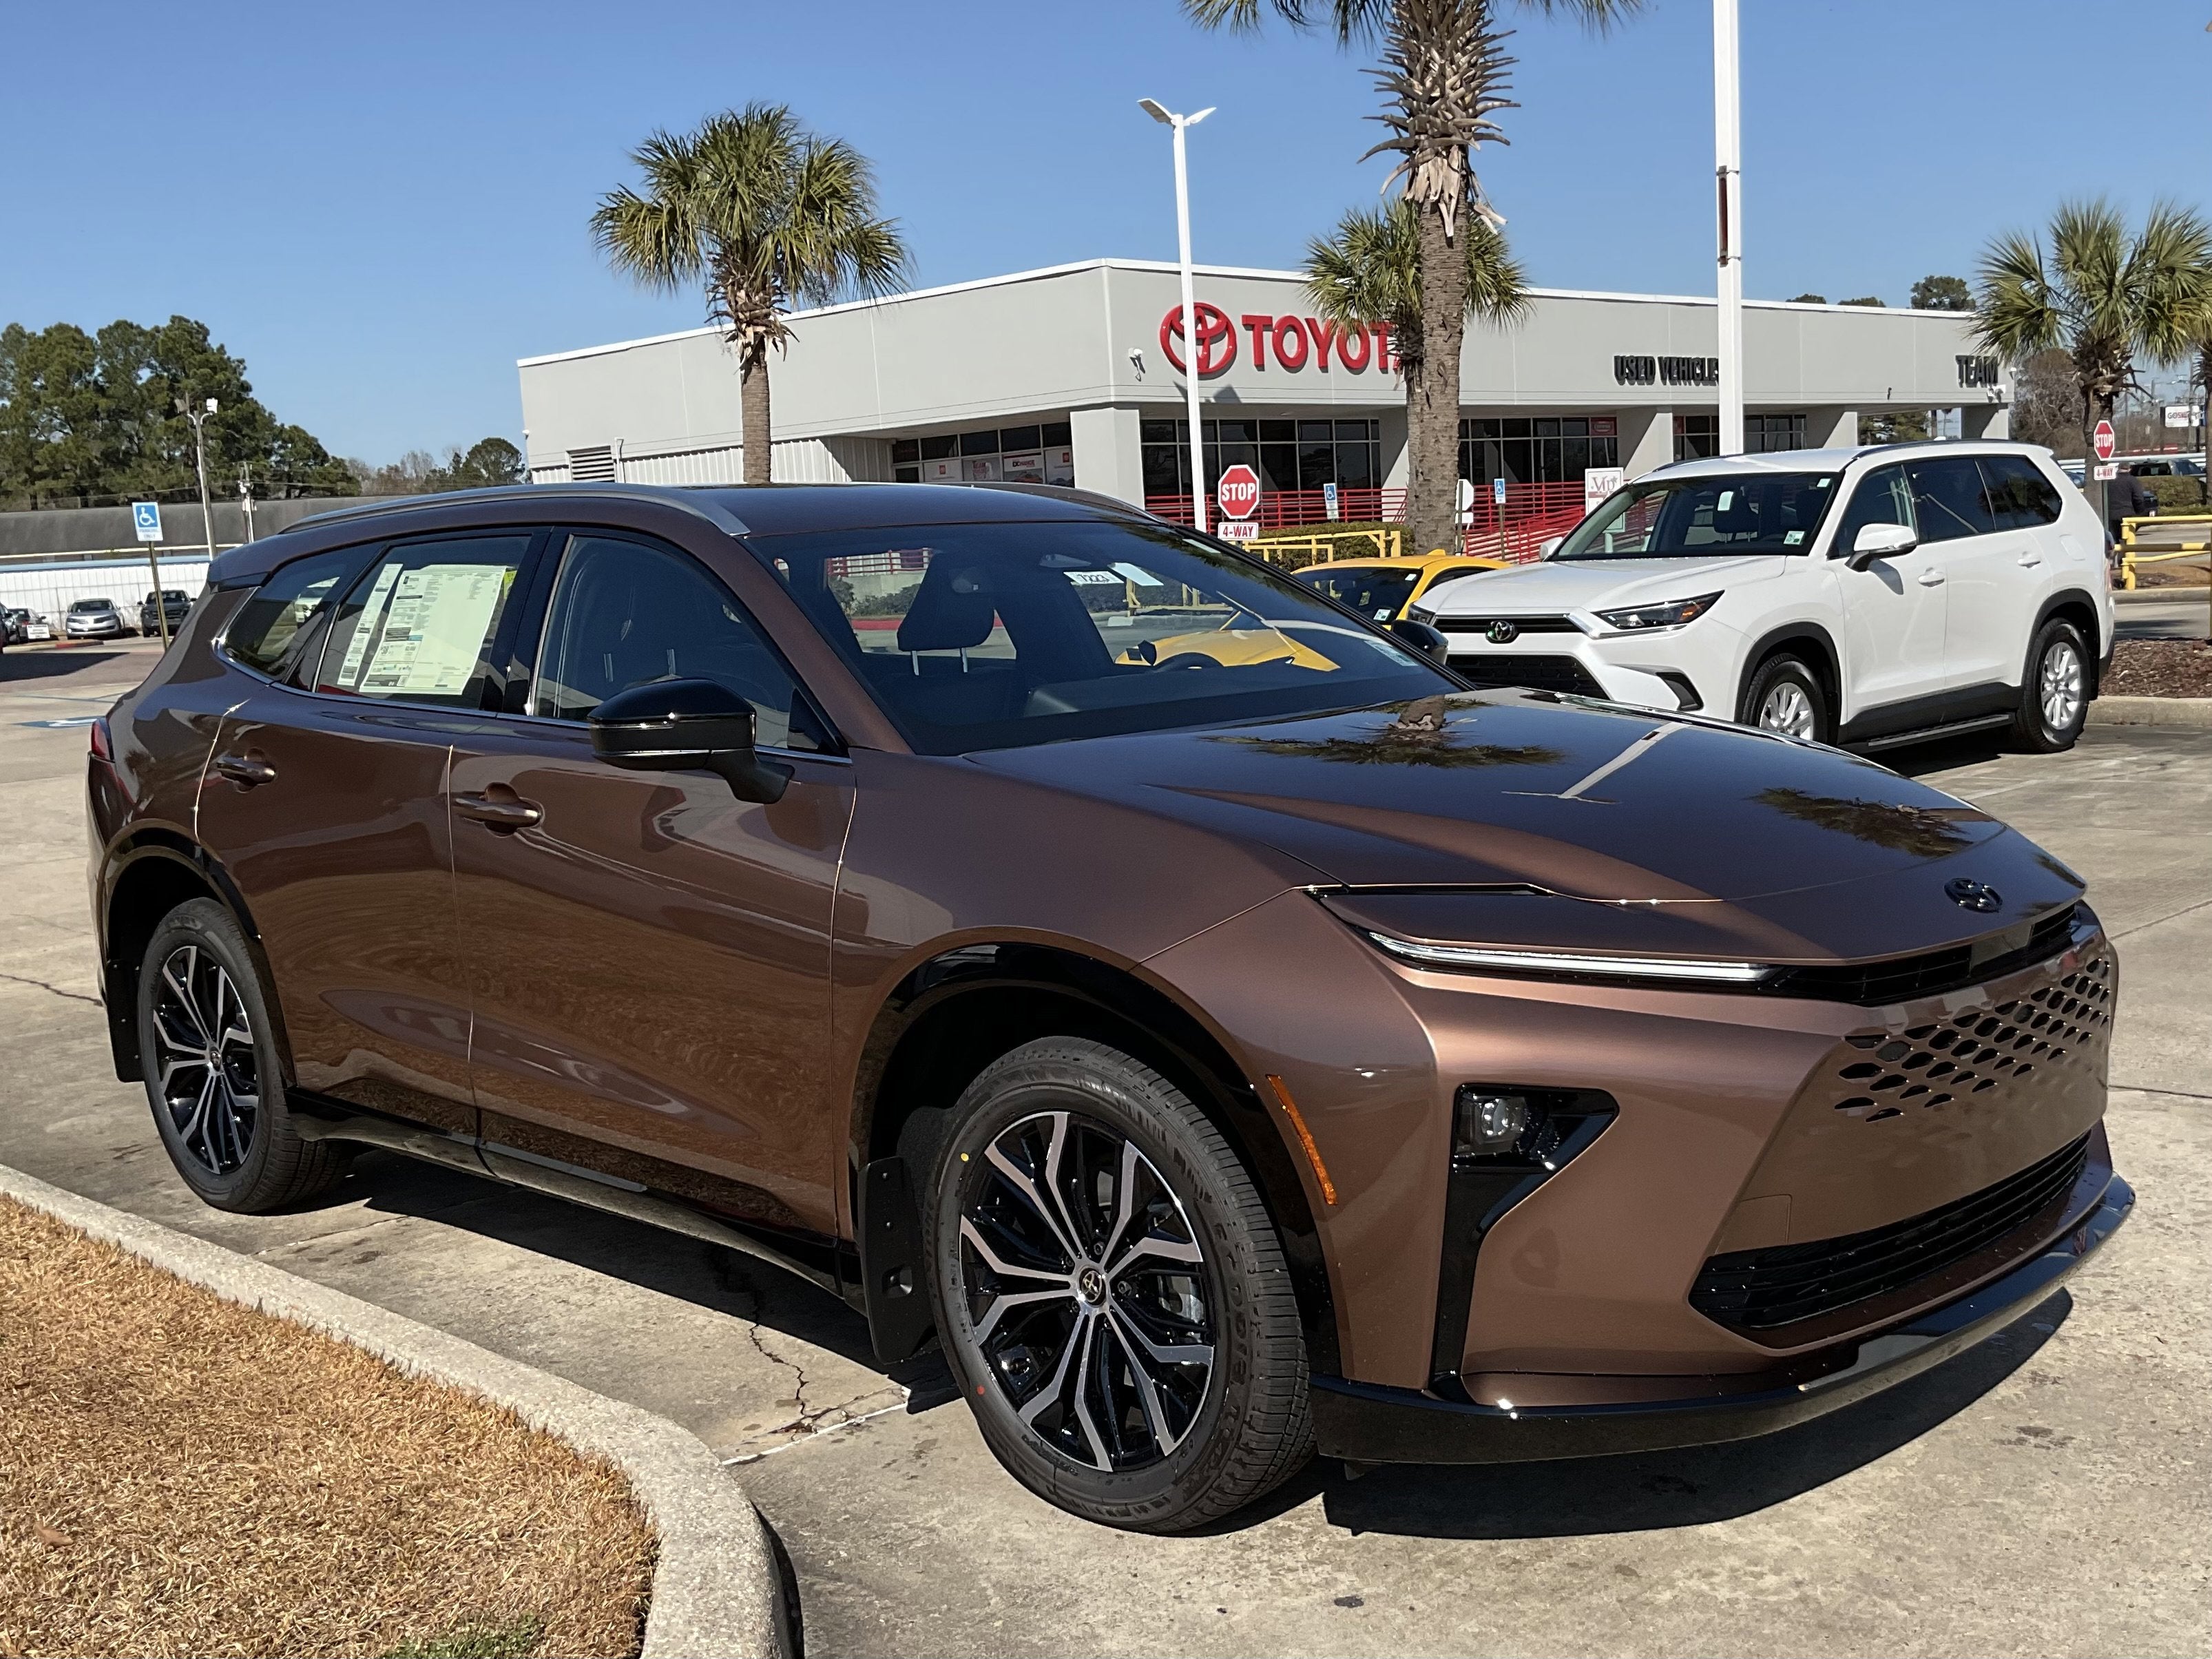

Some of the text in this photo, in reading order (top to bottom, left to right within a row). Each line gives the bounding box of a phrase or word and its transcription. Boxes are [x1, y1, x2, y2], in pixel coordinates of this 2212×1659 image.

[1242, 315, 1403, 374] TOYOT
[1614, 355, 1719, 383] USED VEHICLE
[1955, 355, 1999, 385] TEAM
[2096, 434, 2113, 448] STOP
[2096, 468, 2114, 478] 4-WAY
[1221, 483, 1256, 501] STOP
[1222, 525, 1254, 537] 4-WAY
